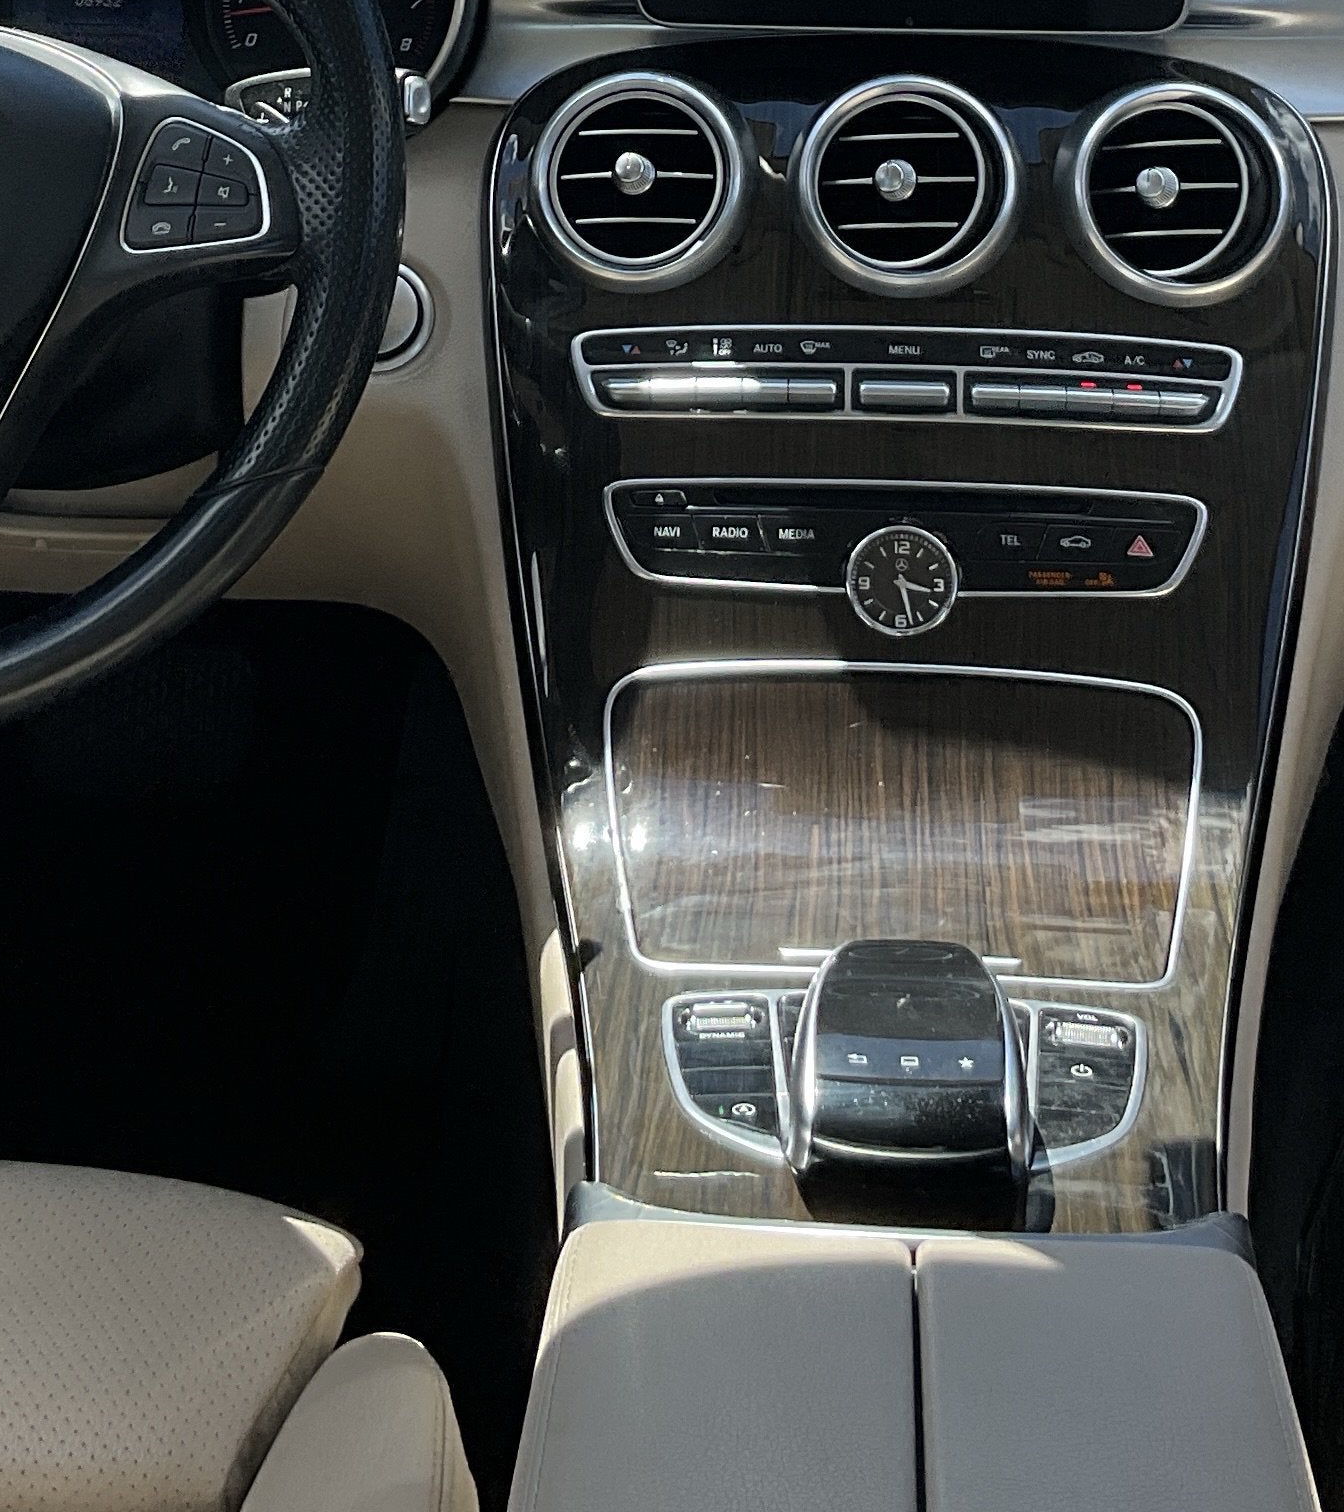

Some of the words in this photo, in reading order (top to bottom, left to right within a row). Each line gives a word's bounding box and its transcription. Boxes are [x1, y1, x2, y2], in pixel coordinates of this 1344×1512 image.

[245, 33, 258, 47] 0
[399, 38, 413, 52] 8
[753, 343, 783, 353] AUTO
[888, 345, 921, 355] MENU
[1026, 349, 1056, 361] SYNC
[1124, 354, 1146, 367] A/C
[653, 526, 681, 538] NAVI
[712, 527, 749, 539] RADIO
[778, 528, 816, 540] MEDIA
[1000, 534, 1022, 546] TEL
[894, 540, 911, 555] 12
[858, 576, 871, 590] 9
[933, 578, 945, 592] 3
[894, 614, 908, 628] 6
[1076, 1012, 1099, 1022] VOL
